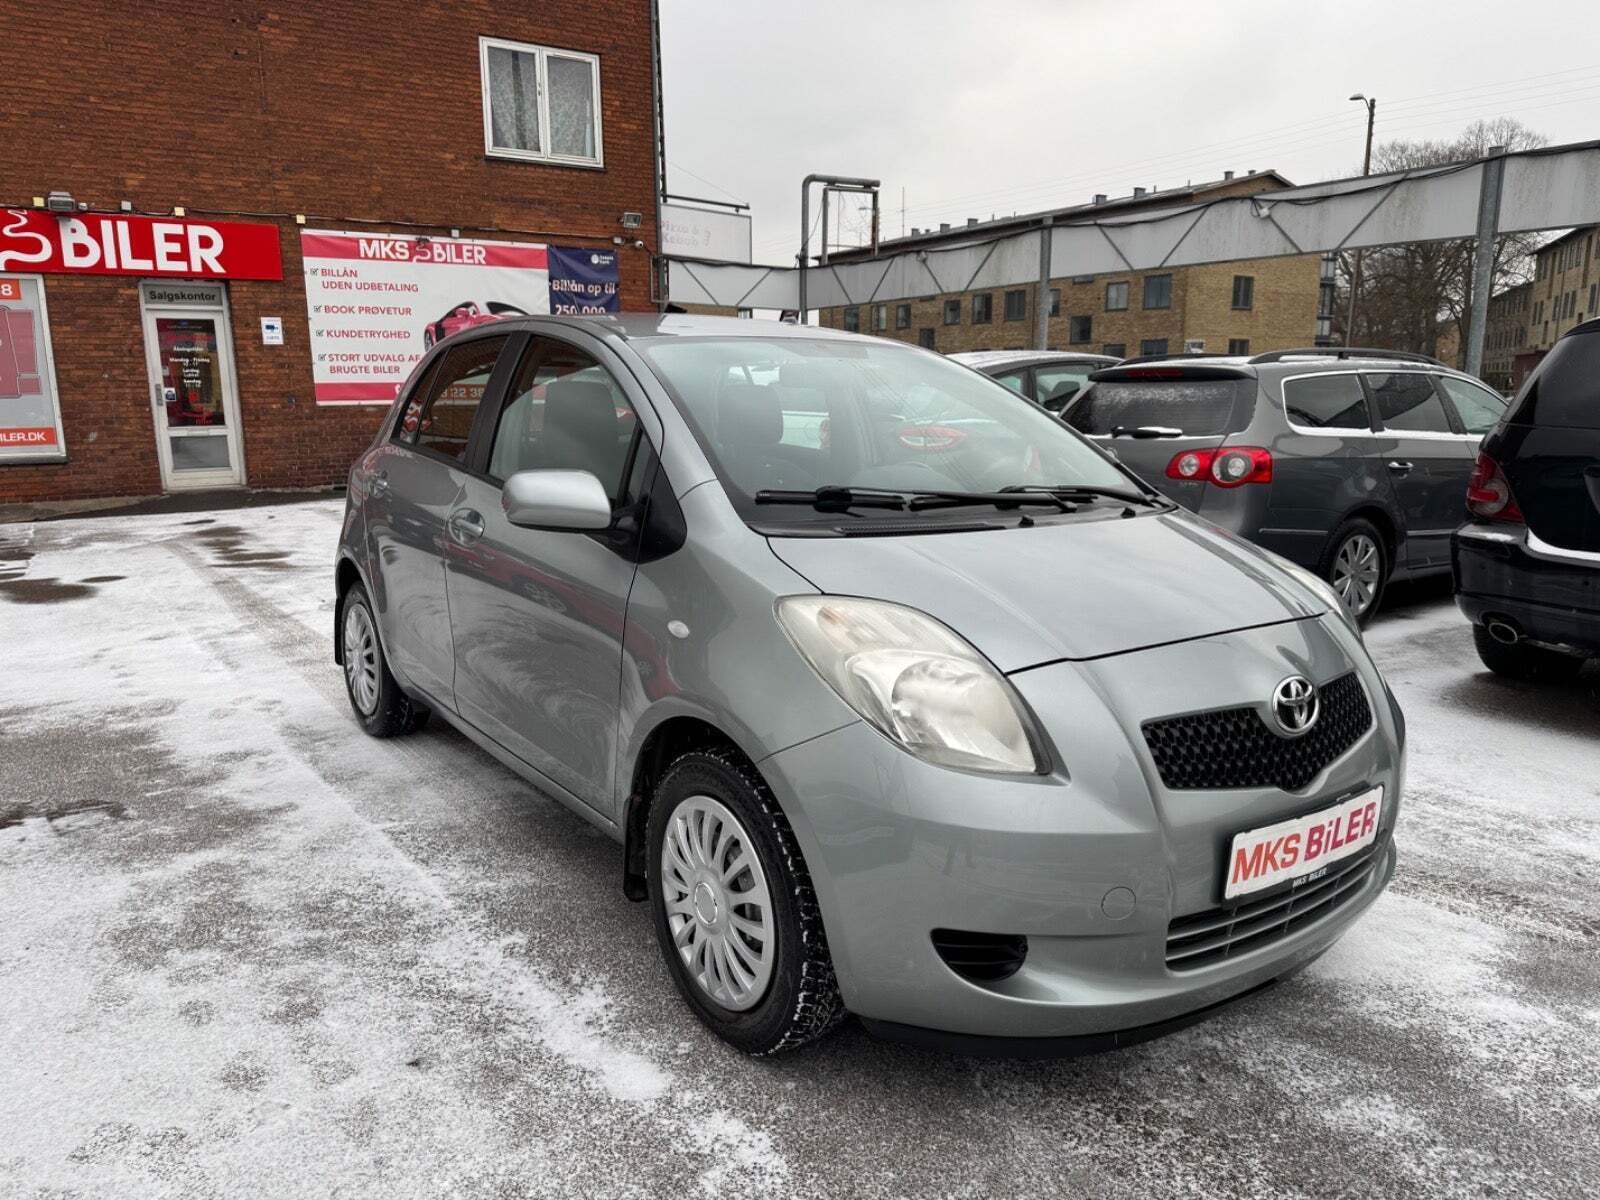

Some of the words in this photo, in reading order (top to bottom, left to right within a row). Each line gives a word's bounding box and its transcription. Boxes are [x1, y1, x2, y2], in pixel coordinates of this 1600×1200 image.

[58, 217, 226, 273] BILER
[358, 238, 410, 260] MKS
[432, 243, 487, 265] BILER
[320, 267, 358, 278] BILLÅN
[322, 280, 352, 290] UDEN
[355, 281, 419, 293] UDBETALING
[587, 284, 602, 297] op
[604, 282, 616, 295] til
[149, 290, 217, 302] Salgskontor
[324, 305, 356, 314] BOOK
[358, 306, 412, 316] PRØVETUR
[326, 330, 411, 339] KUNDETRYGHED
[328, 353, 360, 362] STORT
[363, 353, 405, 362] UDVALG
[408, 354, 421, 362] AF
[330, 365, 370, 374] BRUGTE
[373, 365, 401, 374] BILER
[1232, 833, 1301, 884] MKS
